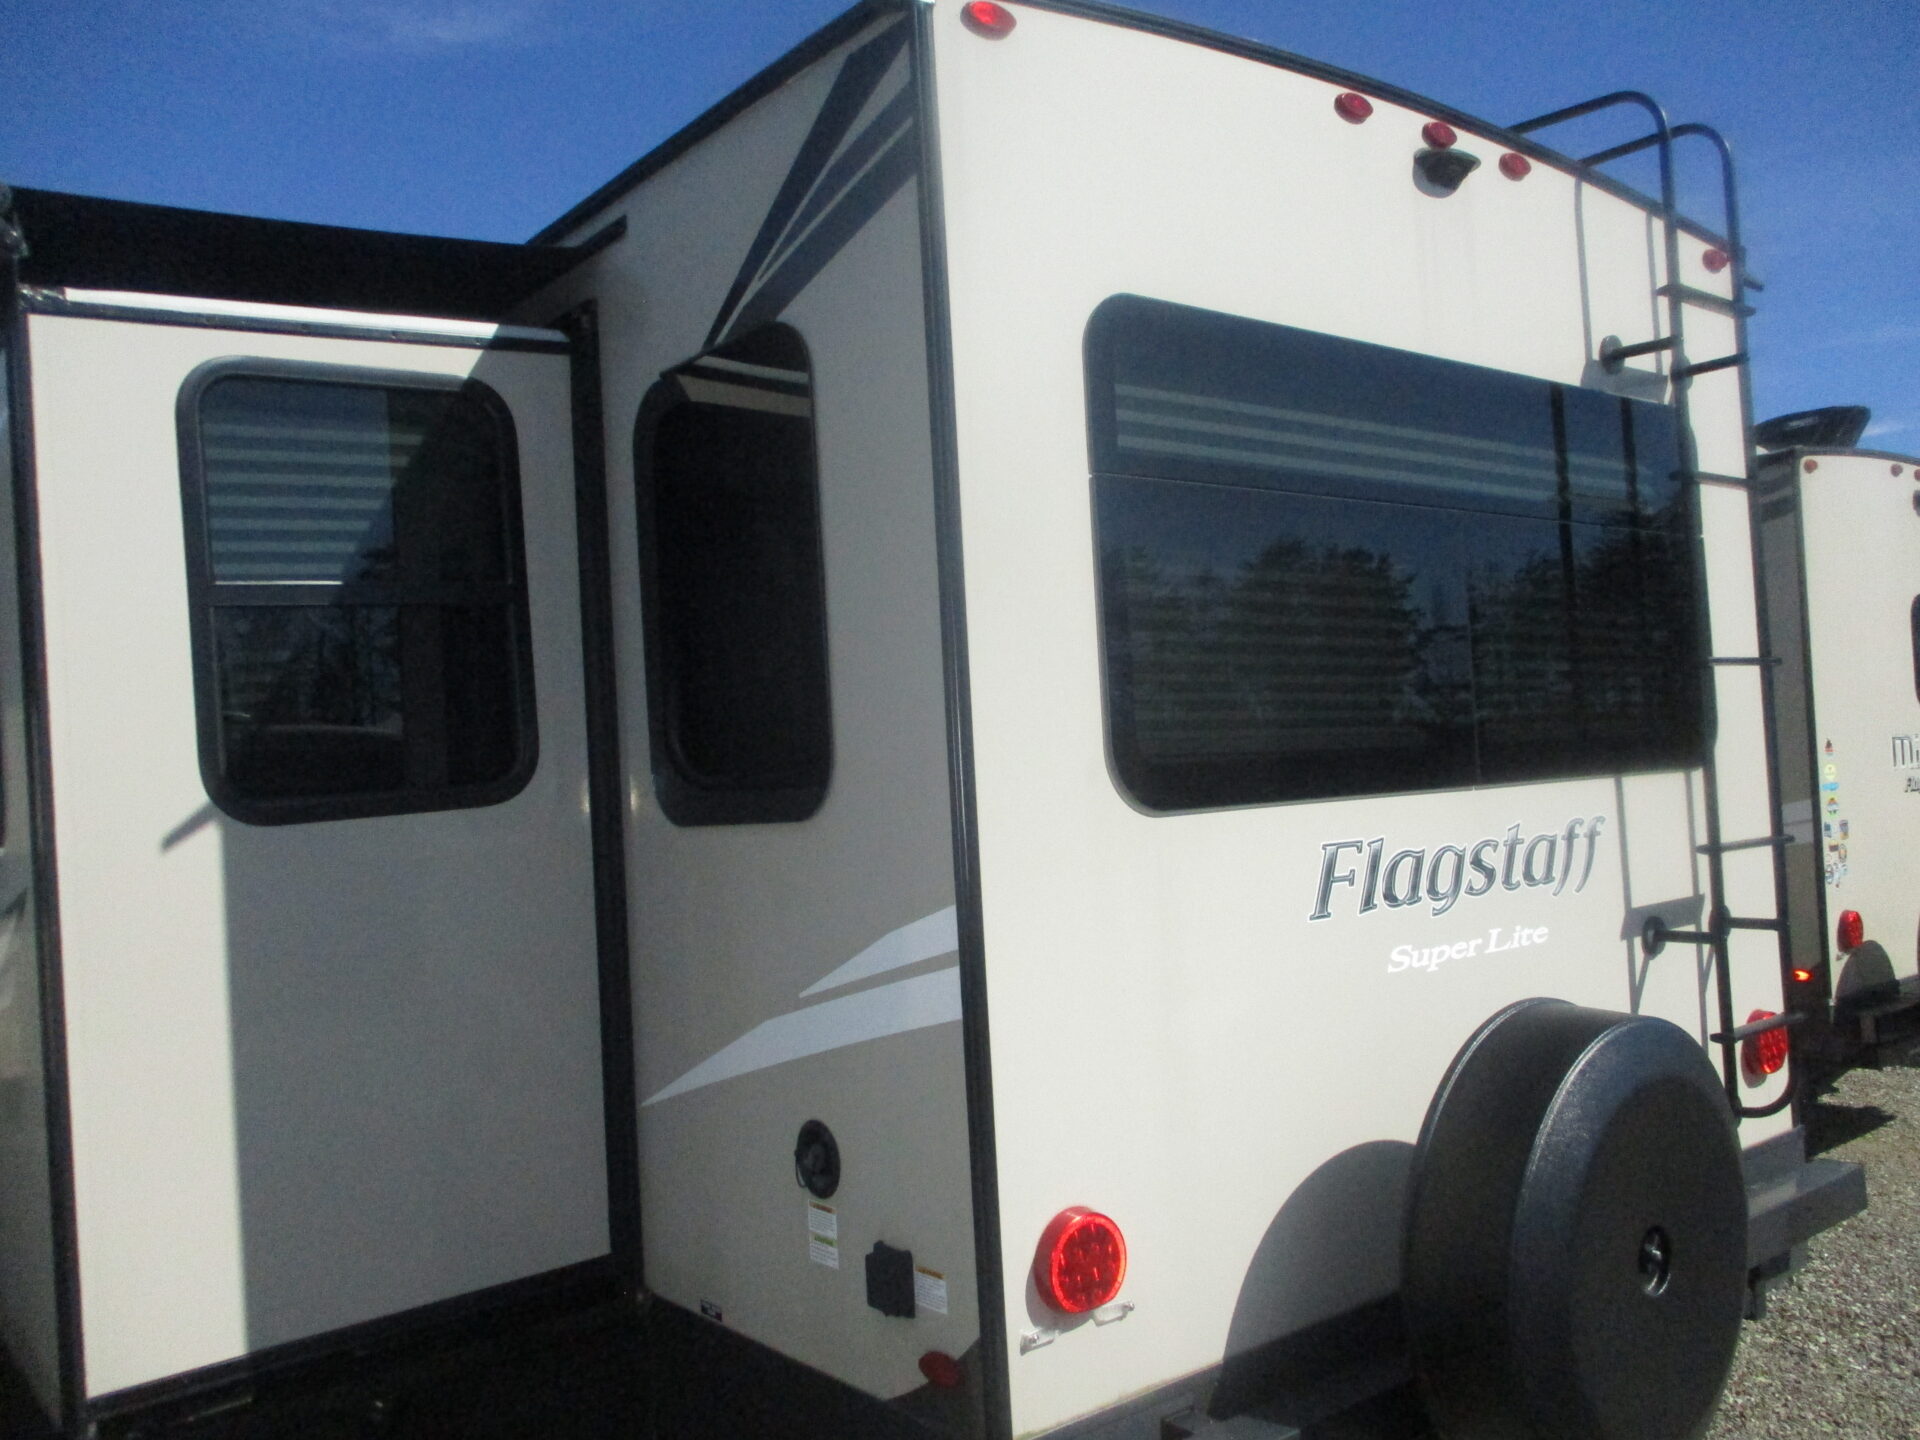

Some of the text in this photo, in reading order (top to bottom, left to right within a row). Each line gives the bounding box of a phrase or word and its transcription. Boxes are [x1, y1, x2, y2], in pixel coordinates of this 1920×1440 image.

[1308, 815, 1606, 921] Flagstaff
[1387, 925, 1549, 973] Super Lite
